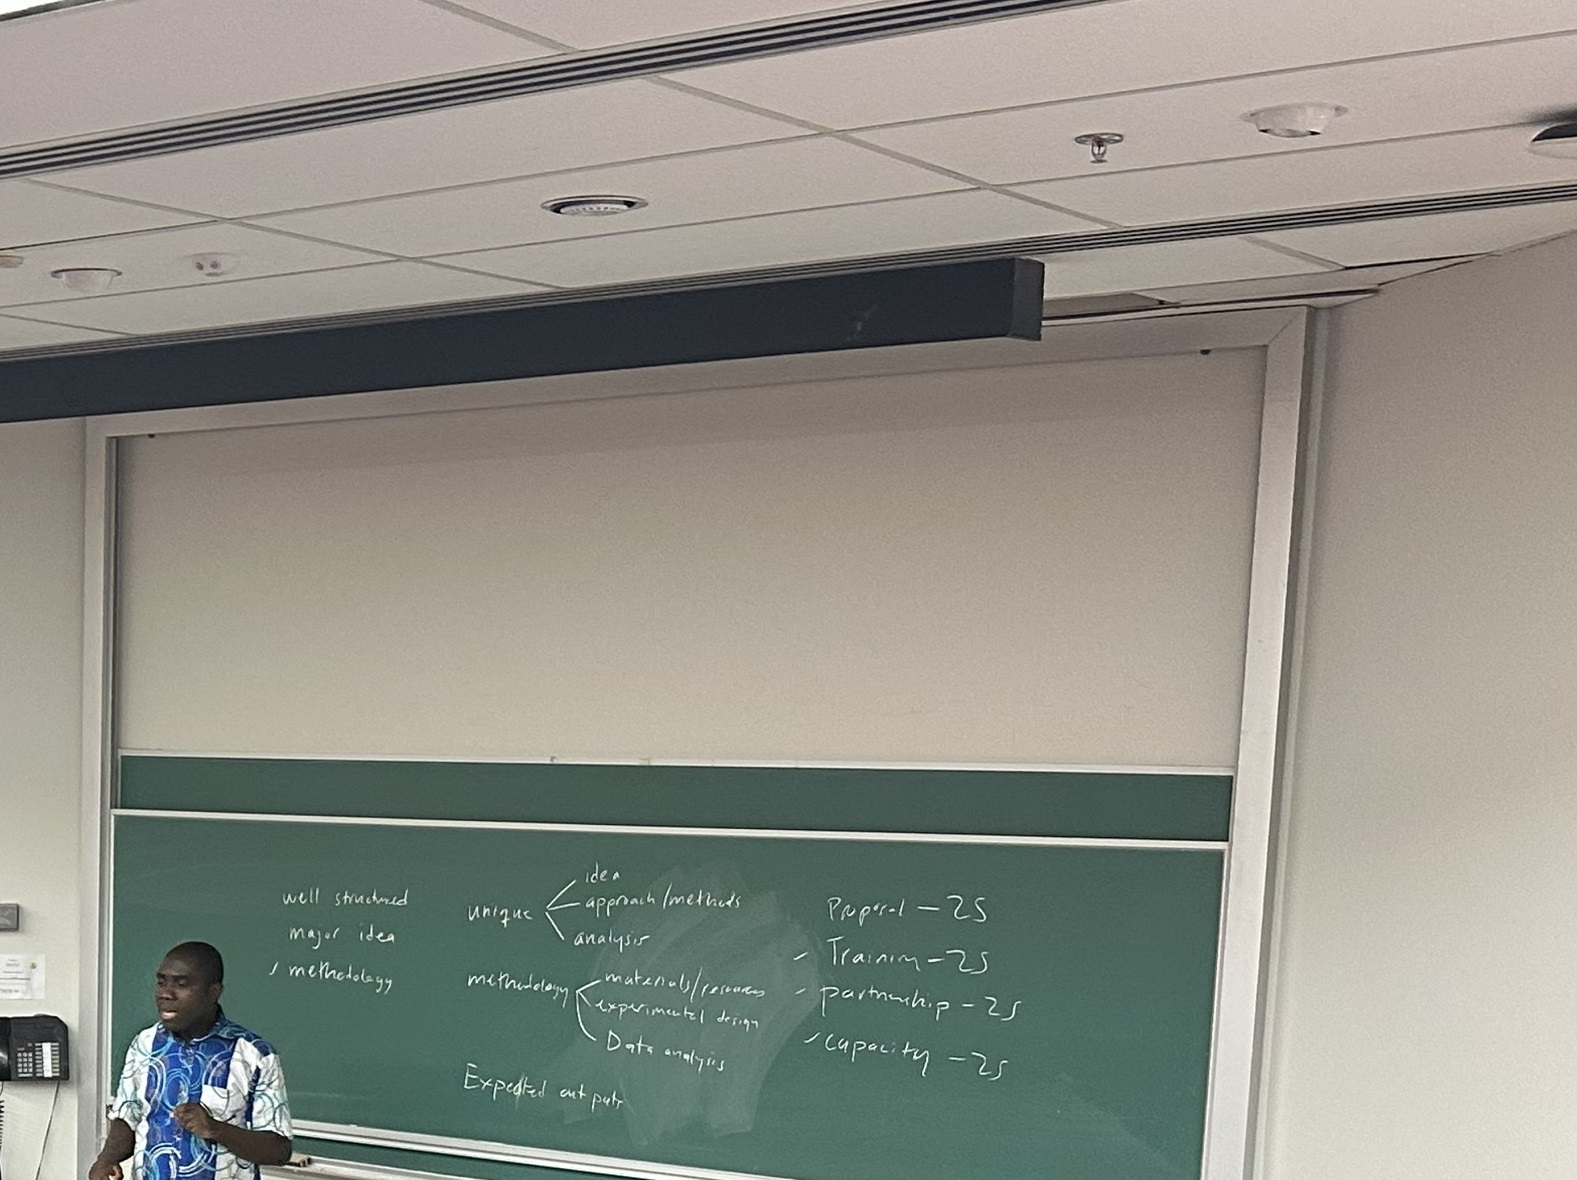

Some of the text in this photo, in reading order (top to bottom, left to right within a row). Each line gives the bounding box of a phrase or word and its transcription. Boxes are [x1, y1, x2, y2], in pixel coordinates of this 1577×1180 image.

[584, 862, 621, 883] idea
[282, 886, 320, 905] well
[467, 904, 533, 928] unique
[288, 922, 395, 950] major idea
[573, 928, 651, 953] analysis
[715, 1008, 760, 1032] design
[606, 1028, 726, 1075] Data analysis
